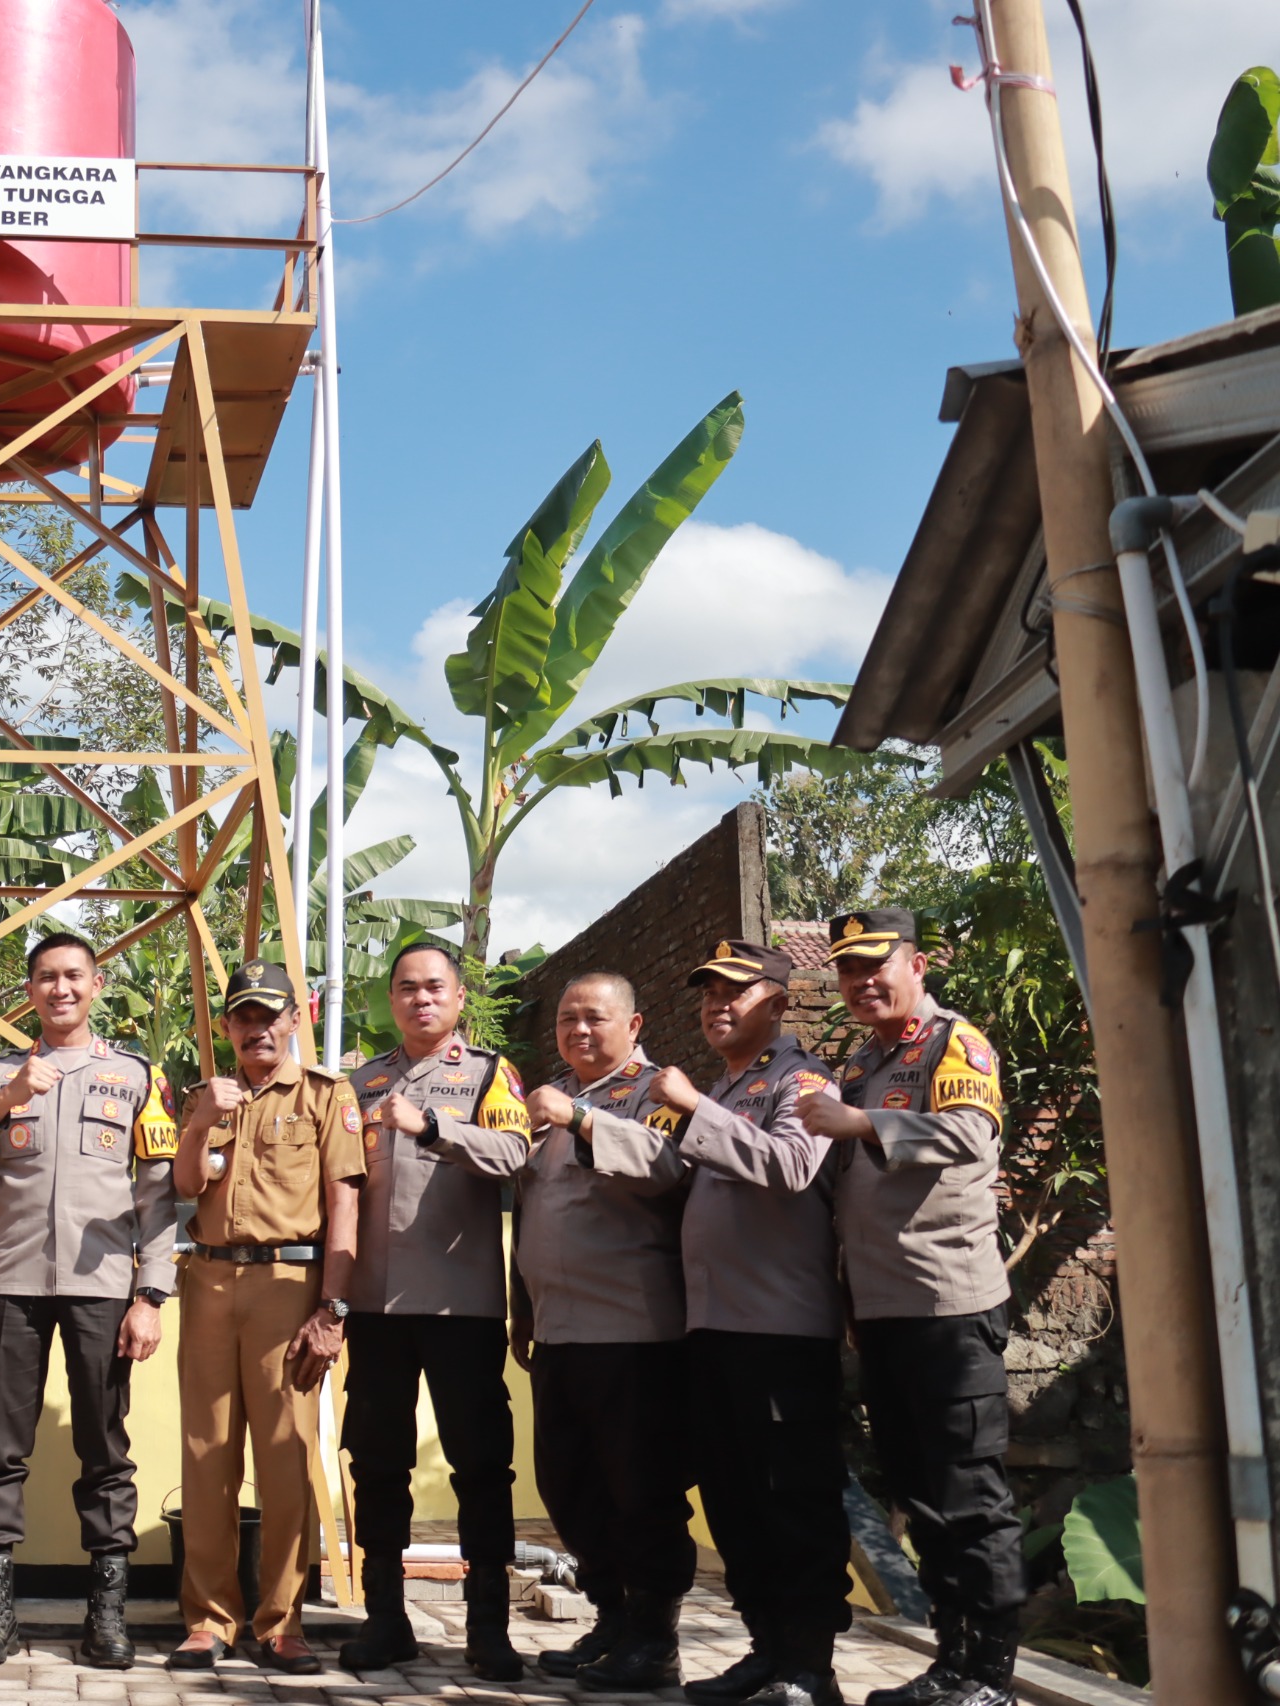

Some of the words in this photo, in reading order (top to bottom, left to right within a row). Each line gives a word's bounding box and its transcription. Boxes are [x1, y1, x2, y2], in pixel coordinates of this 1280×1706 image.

[3, 187, 106, 205] TUNGGA
[888, 1070, 920, 1084] POLRI
[88, 1084, 134, 1102] POLRI
[358, 1087, 392, 1101] JIMMY
[429, 1086, 476, 1097] POLRI
[733, 1096, 766, 1110] POLRI
